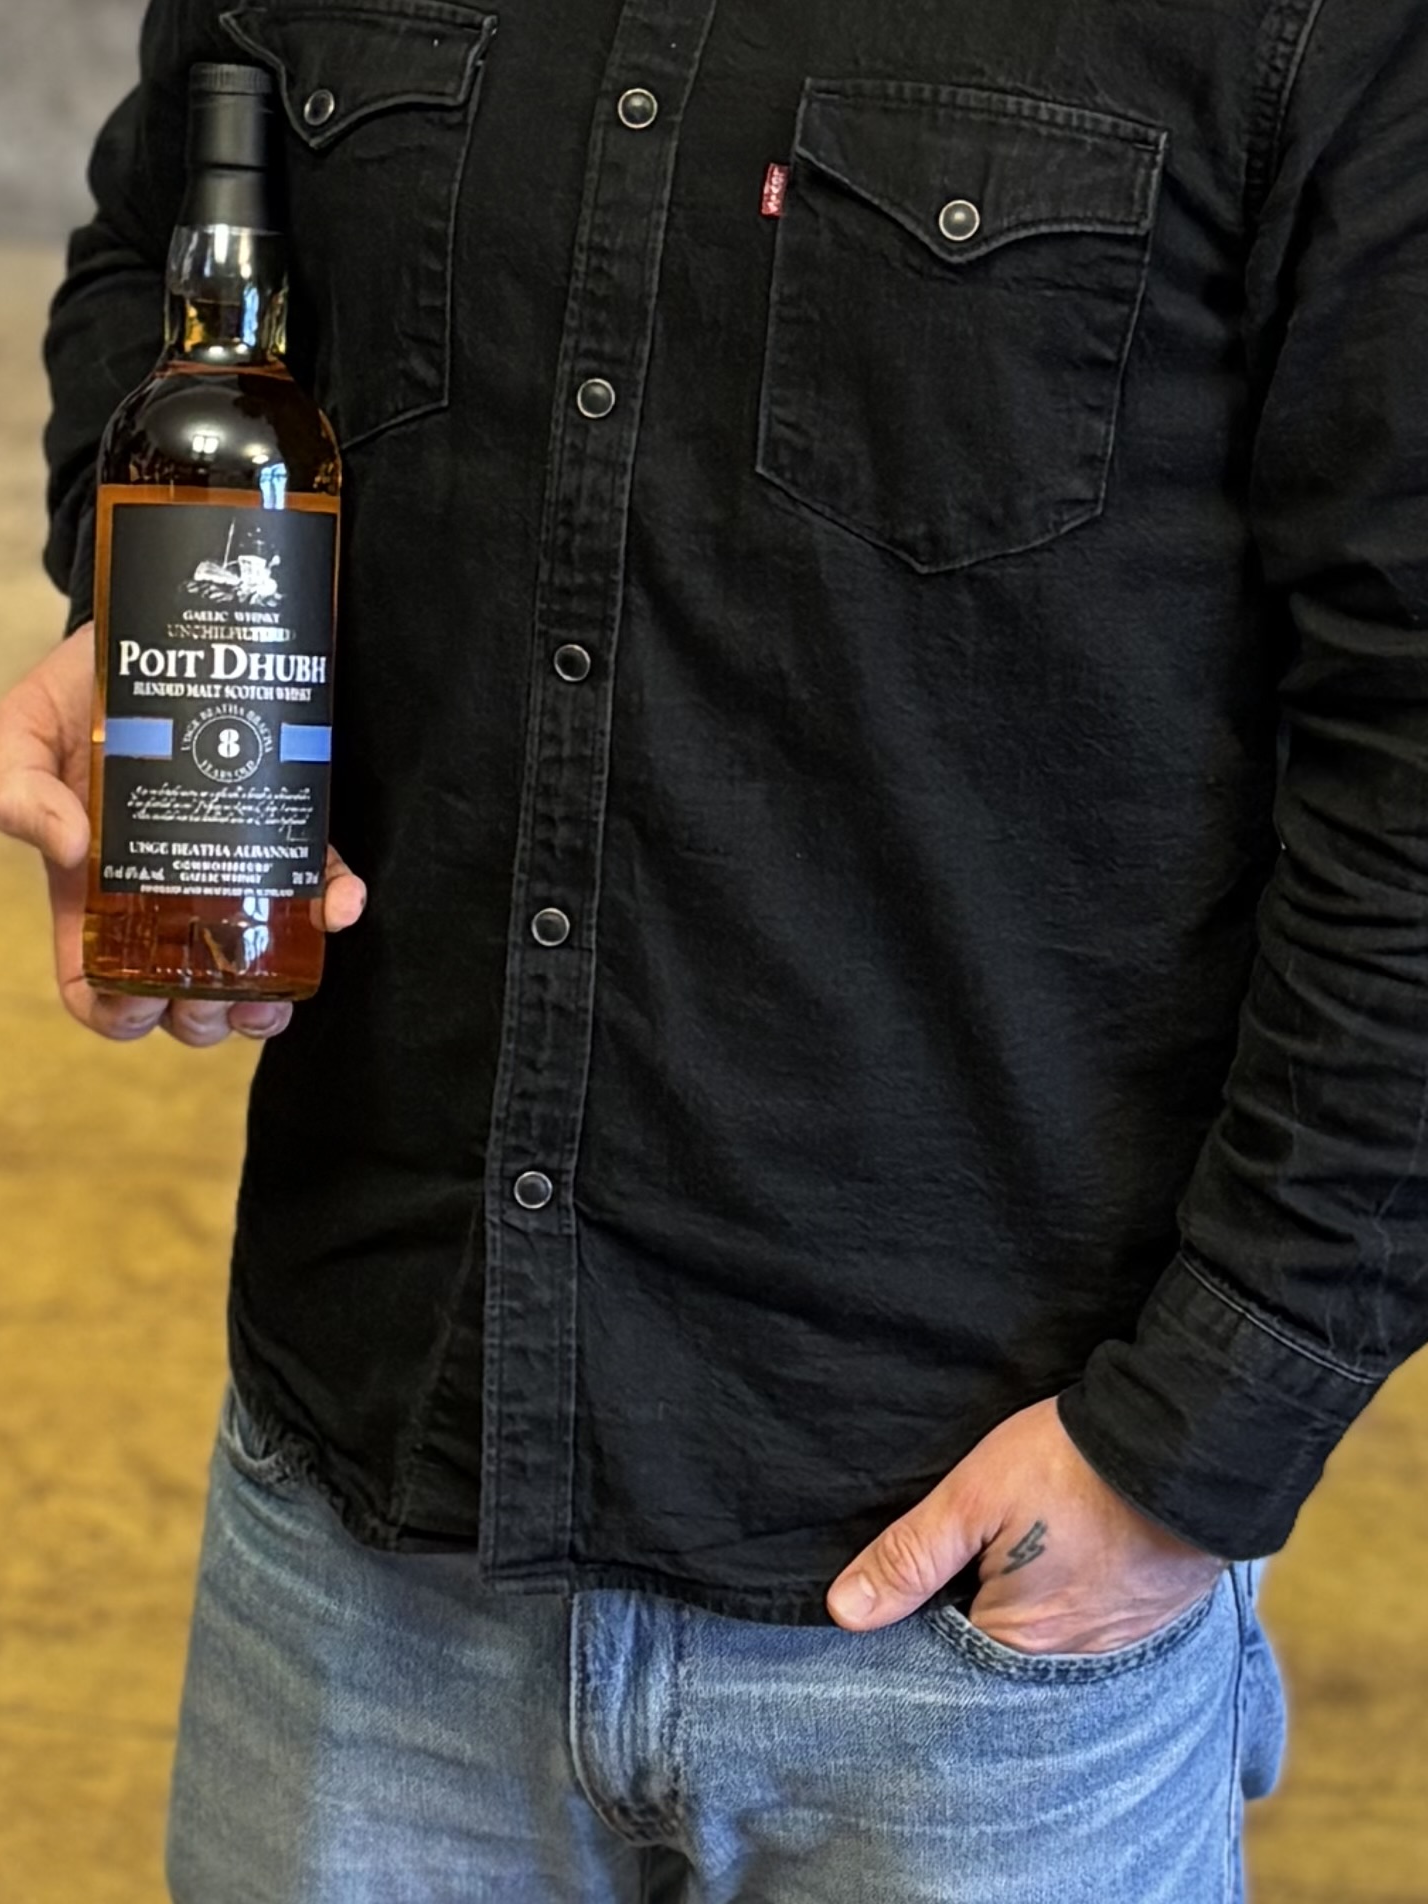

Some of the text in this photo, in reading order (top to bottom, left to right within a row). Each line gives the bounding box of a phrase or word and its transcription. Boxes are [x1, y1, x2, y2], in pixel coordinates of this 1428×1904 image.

[119, 639, 327, 684] POIT DHUBH
[186, 683, 222, 699] MALT
[224, 685, 276, 701] SCOTCH
[217, 728, 241, 759] 8
